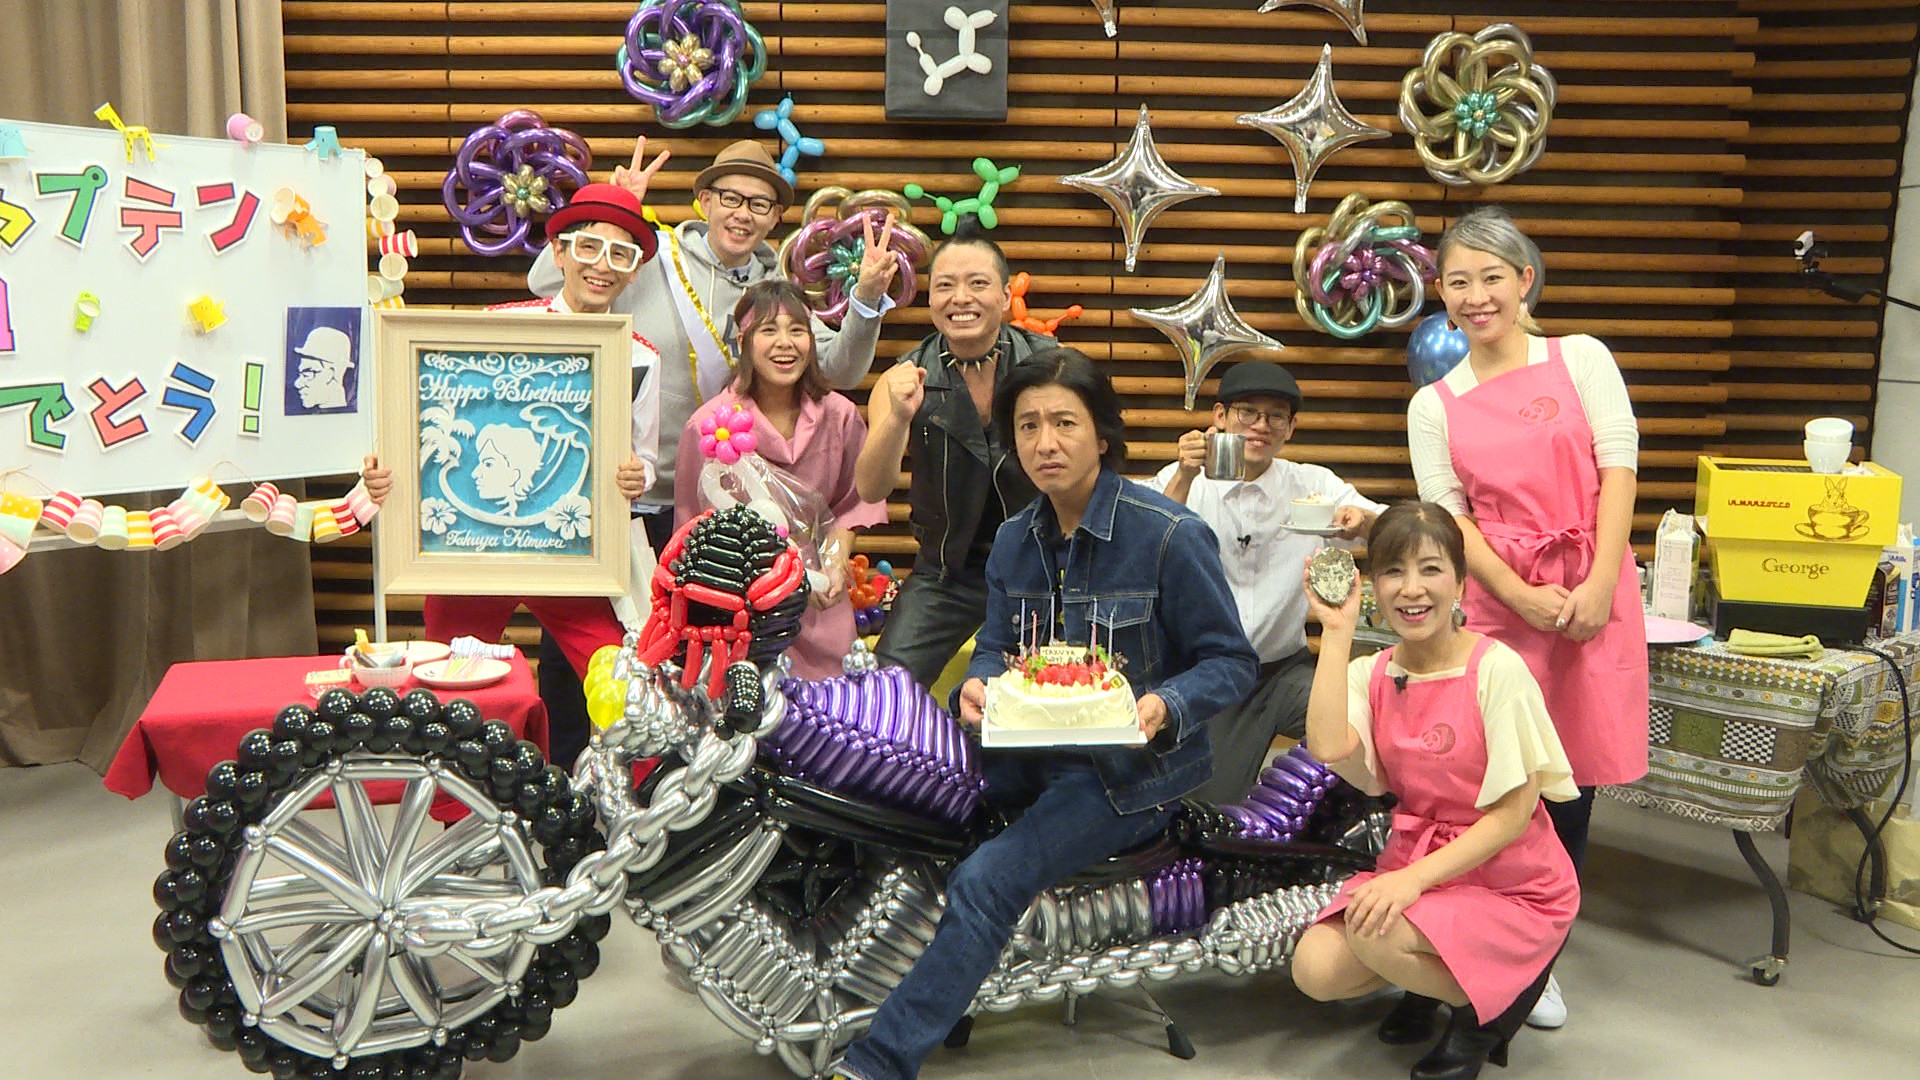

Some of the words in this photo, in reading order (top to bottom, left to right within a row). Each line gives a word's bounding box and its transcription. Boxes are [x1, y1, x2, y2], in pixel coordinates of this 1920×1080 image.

[492, 373, 593, 414] Birthday
[445, 529, 500, 552] Takuya
[502, 527, 567, 549] Kimura
[1761, 558, 1830, 580] George
